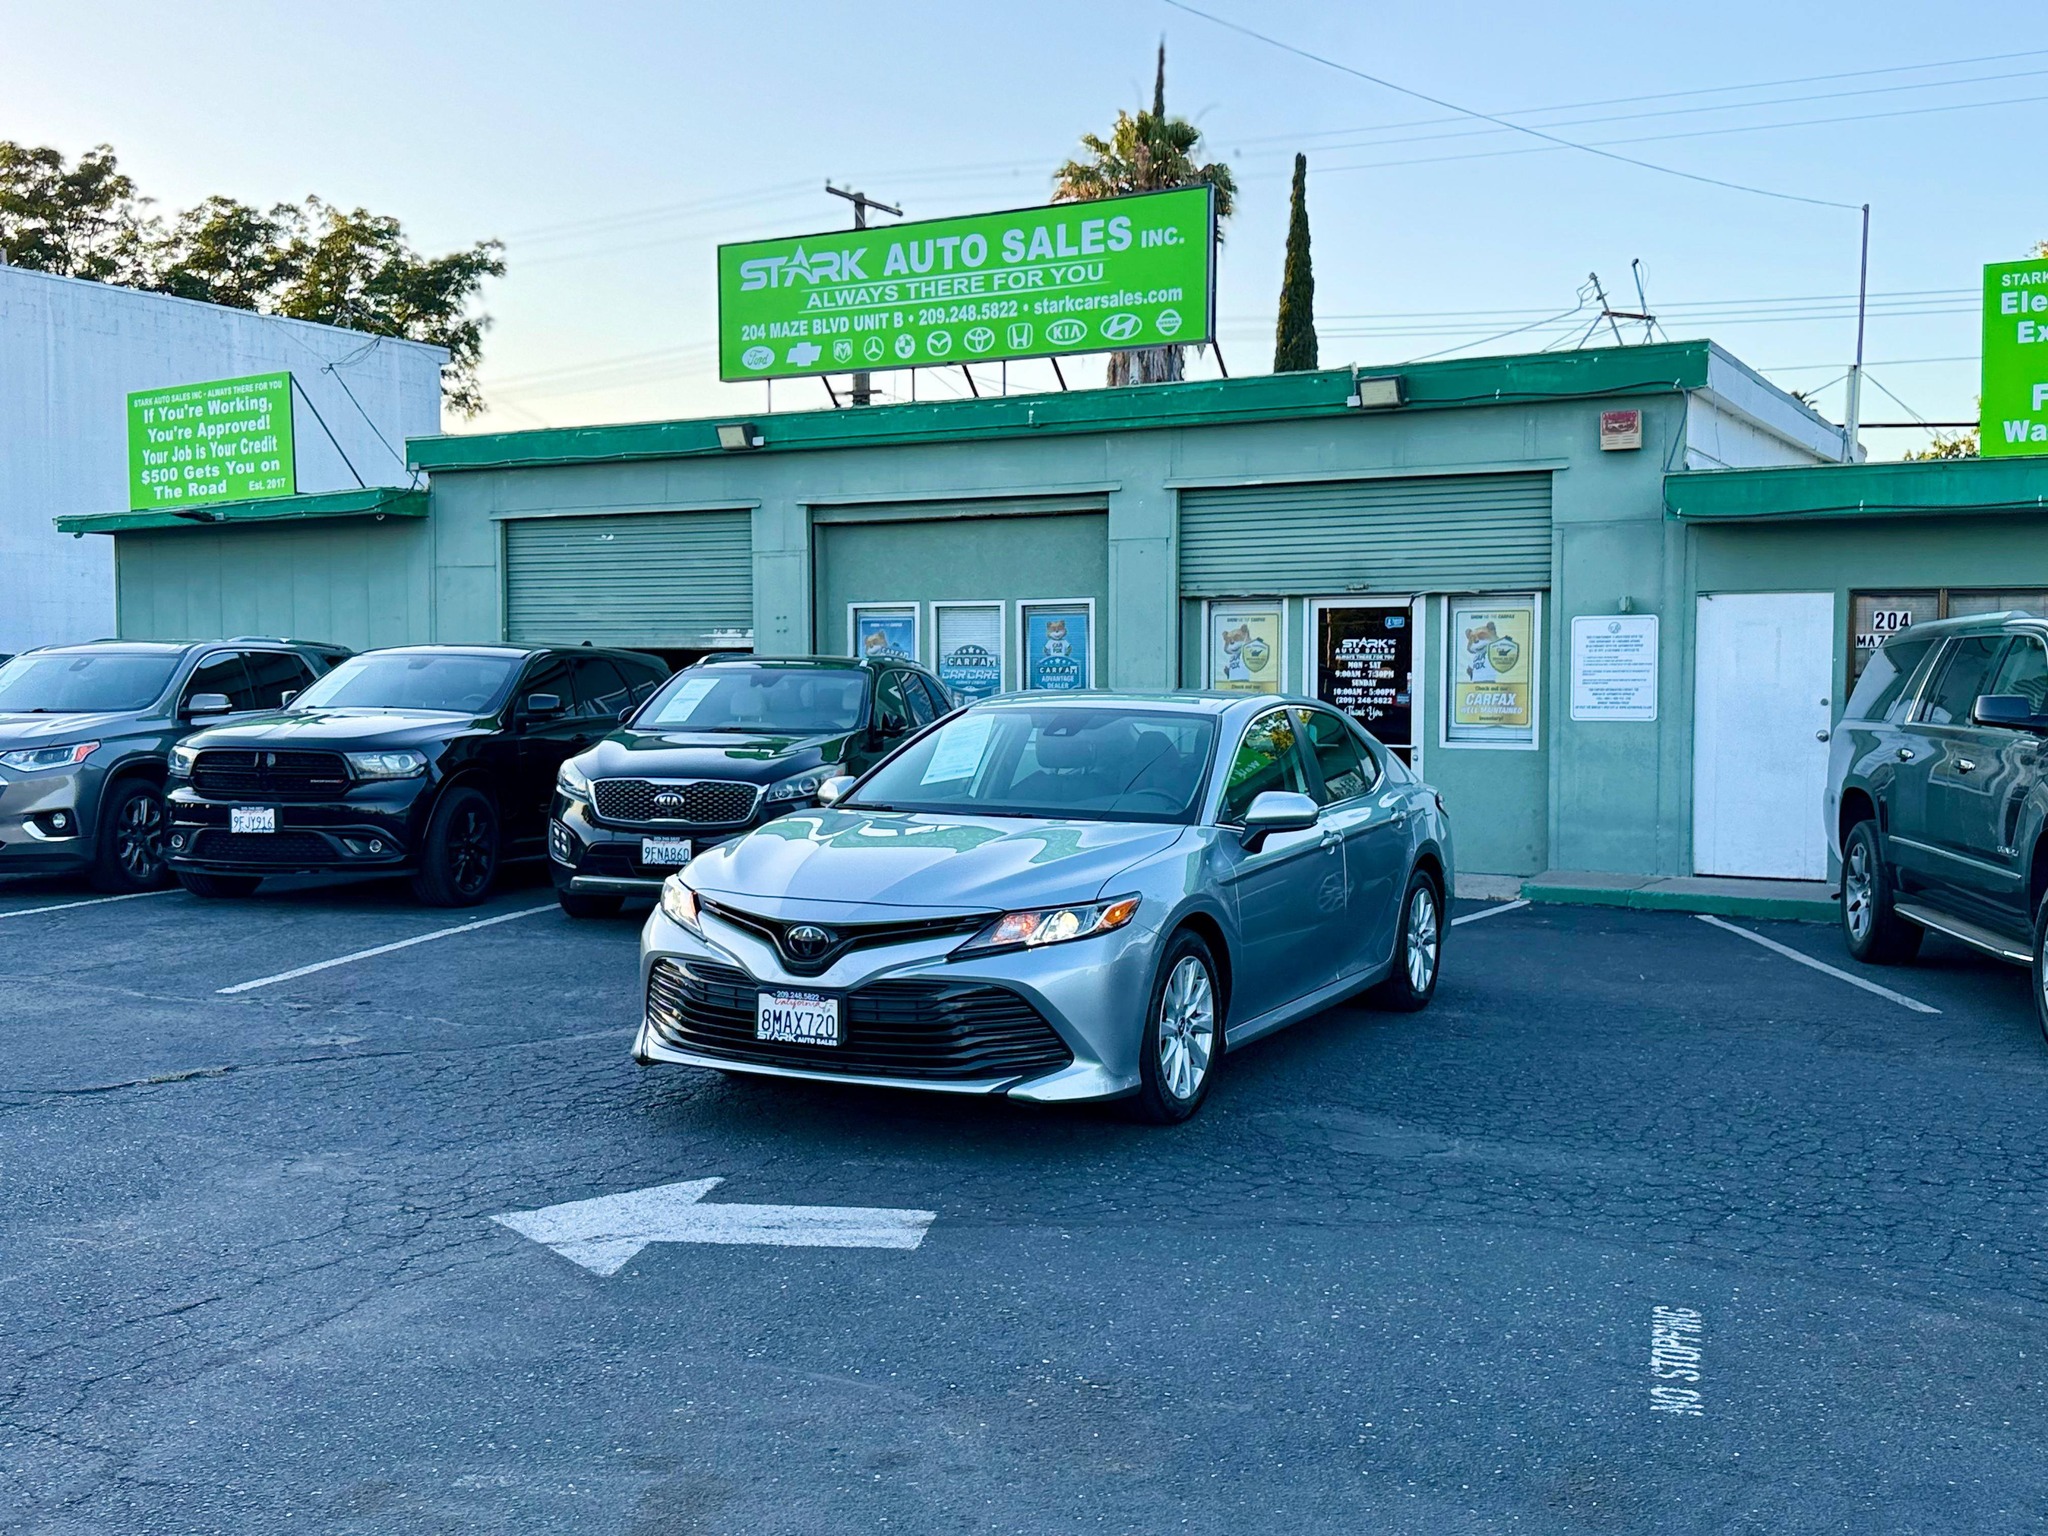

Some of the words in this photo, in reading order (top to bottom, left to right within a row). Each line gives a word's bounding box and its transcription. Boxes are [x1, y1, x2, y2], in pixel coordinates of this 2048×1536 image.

[740, 244, 869, 291] STARK
[884, 233, 988, 276] AUTO
[1002, 216, 1132, 263] SALES
[1141, 227, 1185, 248] INC.
[807, 285, 898, 309] ALWAYS
[906, 276, 985, 299] THERE
[993, 270, 1044, 290] FOR
[1050, 263, 1103, 284] YOU
[2001, 271, 2048, 287] STARK
[741, 324, 766, 341] 204
[770, 320, 808, 338] MAZE
[813, 316, 849, 335] BLVD
[854, 313, 889, 331] UNIT
[893, 312, 903, 328] B
[919, 300, 1018, 326] 209.248.5822
[1034, 288, 1182, 315] starkcarsales.com
[1053, 325, 1081, 340] KIA
[747, 350, 769, 366] Ford
[134, 399, 153, 408] STARK
[154, 395, 170, 404] AUTO
[171, 392, 191, 403] SALES
[192, 391, 202, 400] INC
[207, 386, 232, 397] ALWAYS
[233, 383, 254, 395] THERE
[255, 382, 268, 392] FOR
[269, 380, 282, 390] YOU
[143, 408, 154, 424] If
[158, 404, 203, 422] You're
[207, 396, 272, 416] Working,
[148, 425, 192, 443] You're
[197, 414, 271, 440] Approved!
[2003, 420, 2048, 443] Wa
[142, 448, 168, 465] Your
[171, 445, 192, 462] Job
[196, 444, 206, 460] is
[209, 441, 236, 458] Your
[240, 435, 277, 455] Credit
[141, 466, 178, 485] $500
[183, 464, 220, 480] Gets
[225, 461, 254, 476] You
[261, 460, 280, 472] on
[154, 484, 182, 500] The
[188, 480, 227, 496] Road
[248, 481, 264, 491] Est.
[266, 477, 286, 490] 2017
[1875, 612, 1909, 629] 204
[1342, 636, 1387, 648] STARK
[1856, 635, 1894, 647] MAZ
[948, 657, 996, 668] CARFAX
[1040, 666, 1077, 674] CARFAX
[1369, 661, 1381, 669] SAT
[1335, 670, 1361, 678] 9:00AM
[1367, 670, 1394, 678] 7:30PM
[1351, 679, 1377, 687] SUNDAY
[1333, 688, 1362, 696] 10:00AM
[1369, 688, 1396, 696] 5:00PM
[1466, 693, 1516, 706] CARFAX
[1335, 697, 1355, 705] (209)
[1344, 705, 1365, 716] Thank
[1366, 706, 1383, 721] You
[659, 796, 679, 806] KIA
[762, 1008, 835, 1037] 8MAX720
[757, 1029, 797, 1042] STARK
[816, 1038, 837, 1046] SALES
